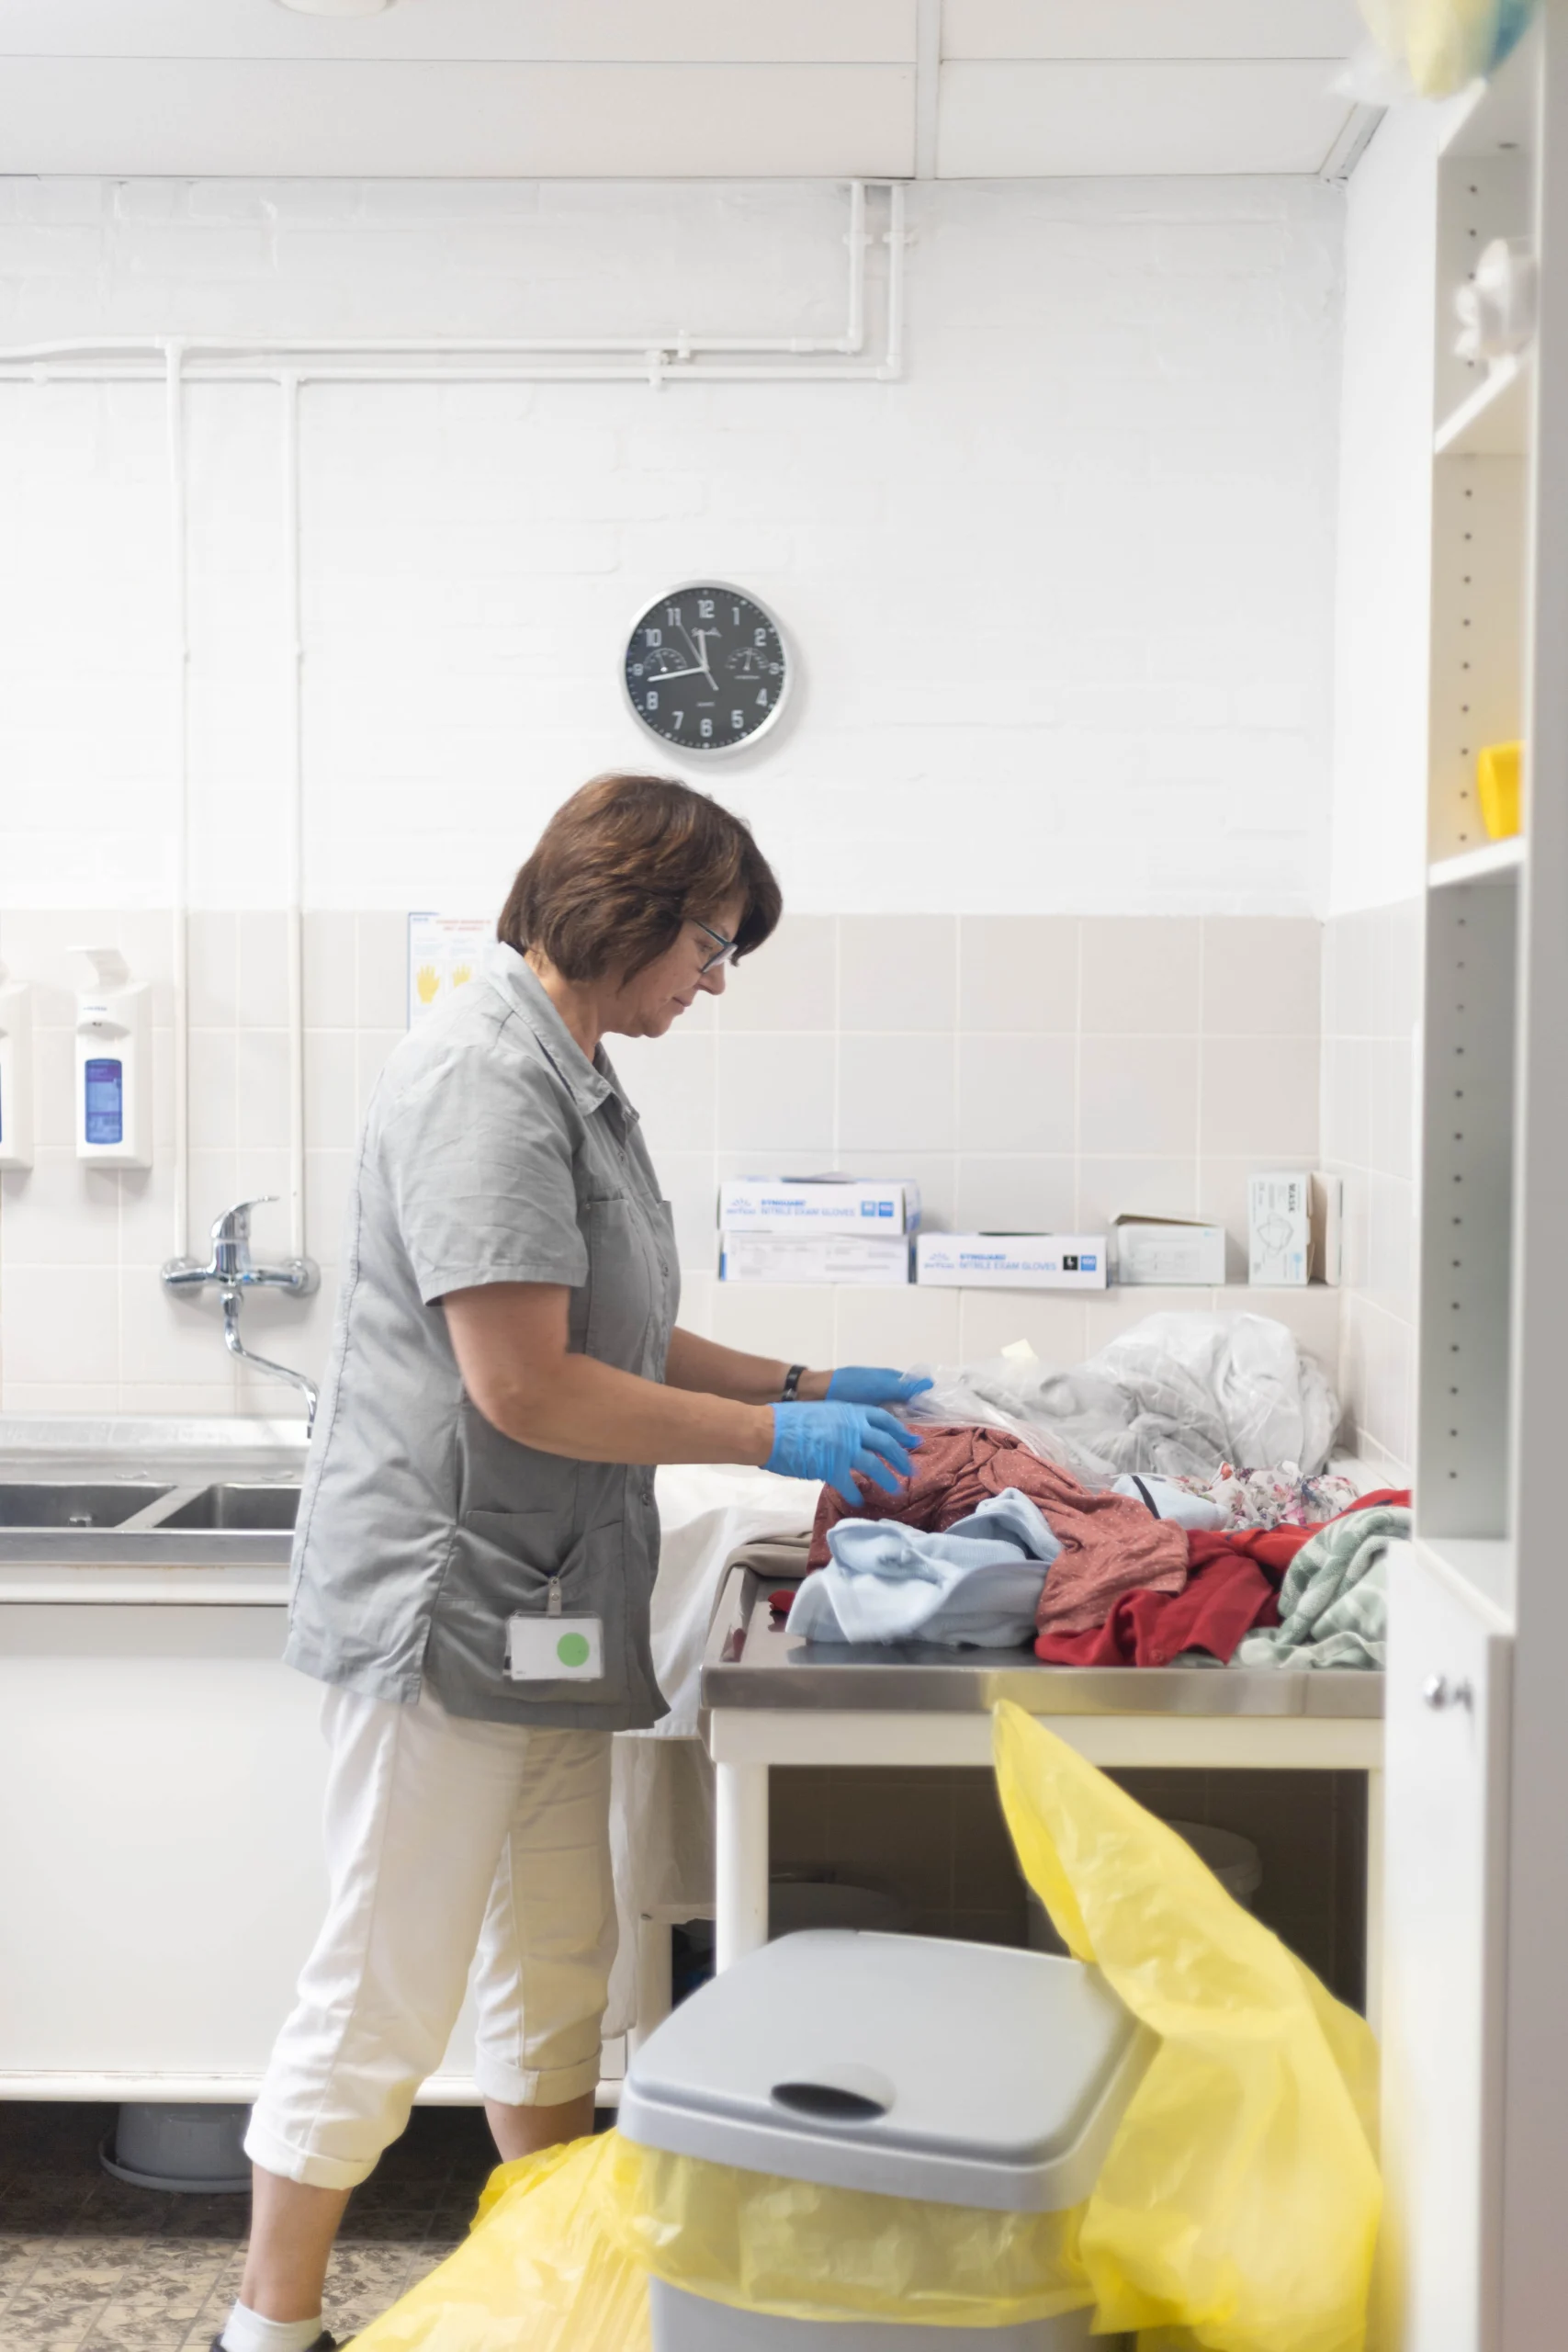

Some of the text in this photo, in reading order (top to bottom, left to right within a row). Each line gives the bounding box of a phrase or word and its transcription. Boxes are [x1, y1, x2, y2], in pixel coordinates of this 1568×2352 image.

[667, 607, 681, 627] 11
[697, 600, 715, 618] 12
[732, 607, 740, 626] 1
[645, 628, 661, 647] 10
[754, 628, 767, 647] 2
[769, 662, 780, 674] 3
[647, 692, 659, 710] 8
[755, 688, 768, 707] 4
[672, 711, 684, 729] 7
[700, 718, 712, 737] 6
[731, 710, 743, 729] 5
[761, 1206, 791, 1216] NITRILE
[795, 1207, 819, 1216] EXAM
[821, 1208, 855, 1217] GLOVES
[959, 1261, 991, 1270] NITRILE
[994, 1261, 1020, 1271] EXAM
[1022, 1261, 1057, 1271] GLOVES
